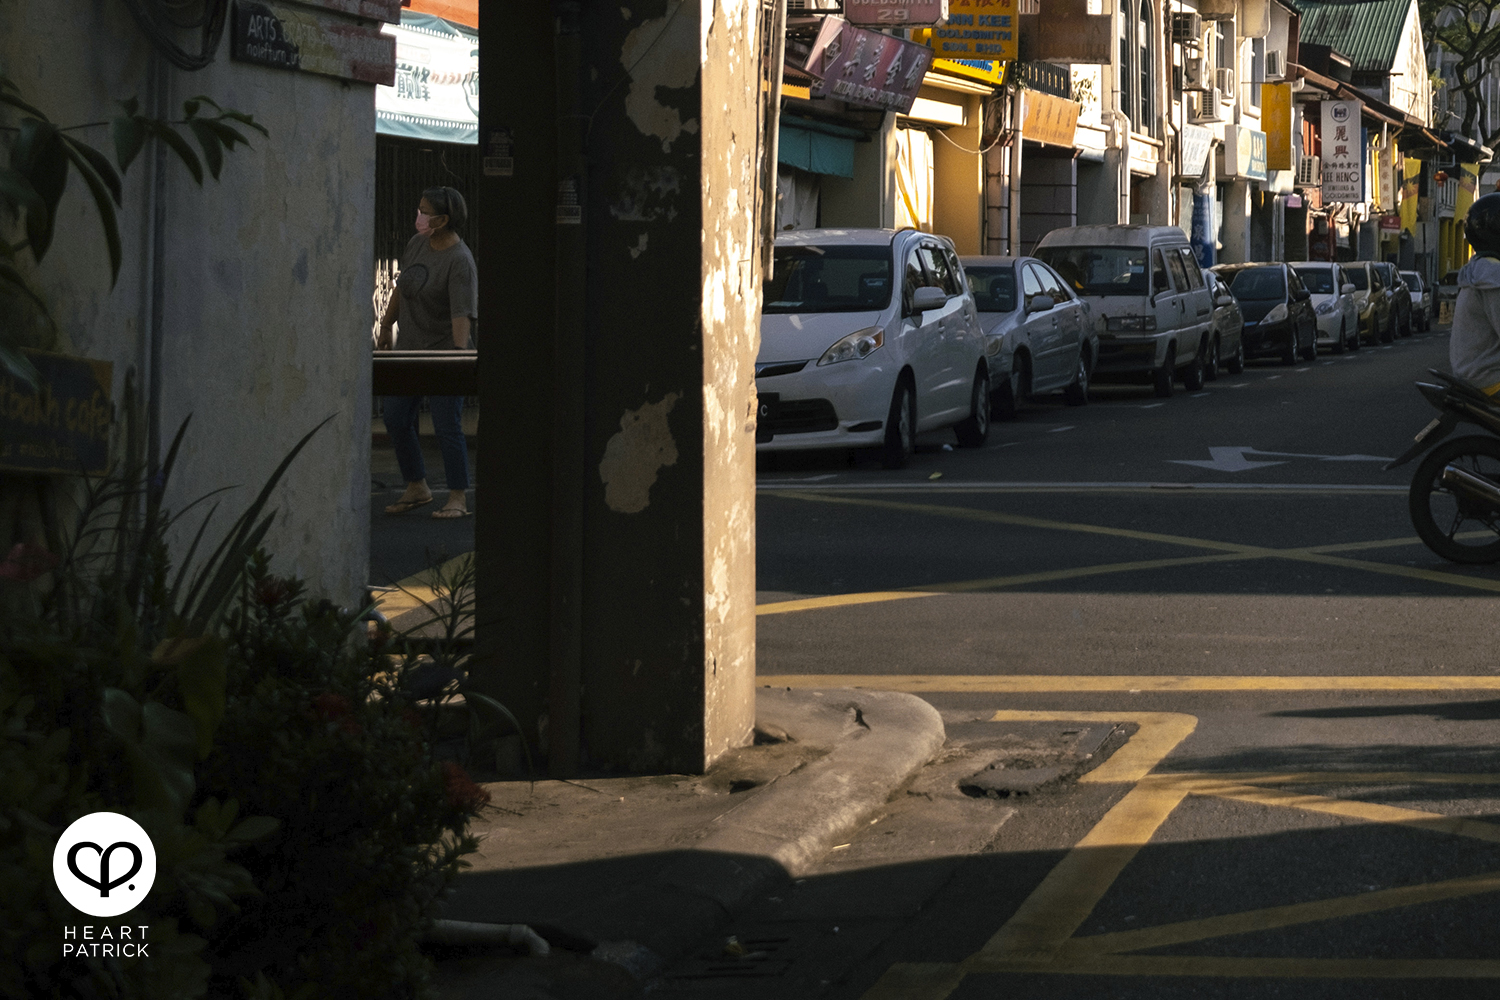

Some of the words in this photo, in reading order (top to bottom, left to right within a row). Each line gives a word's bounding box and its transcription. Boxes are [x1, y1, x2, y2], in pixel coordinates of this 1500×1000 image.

[877, 8, 911, 22] 29
[978, 14, 1011, 27] KEE
[936, 28, 1012, 40] GOLDSMITH
[942, 41, 971, 52] SDN.
[975, 42, 1005, 54] BHD.
[1333, 125, 1349, 159] 麗興
[1323, 171, 1333, 183] LEE
